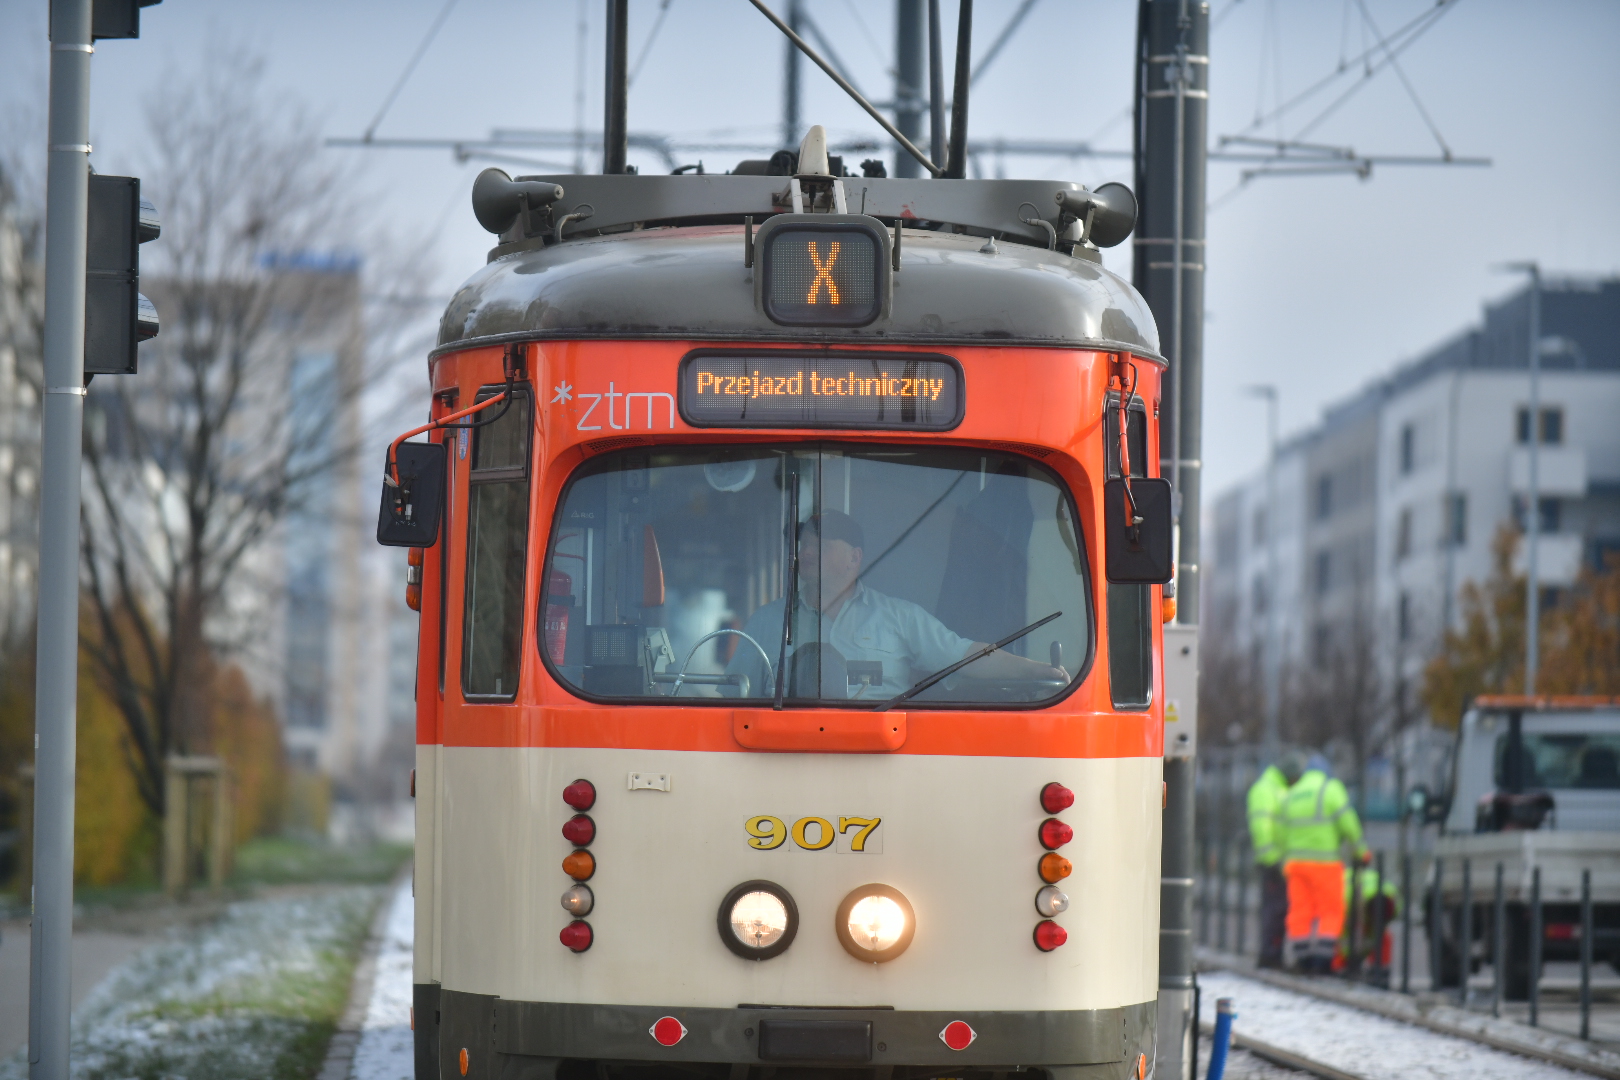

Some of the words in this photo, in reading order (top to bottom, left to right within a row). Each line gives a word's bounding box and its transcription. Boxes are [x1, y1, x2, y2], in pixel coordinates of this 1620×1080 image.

[808, 241, 840, 304] X
[697, 371, 803, 399] Przejazd
[809, 371, 943, 401] techniczny
[745, 815, 882, 852] 907
